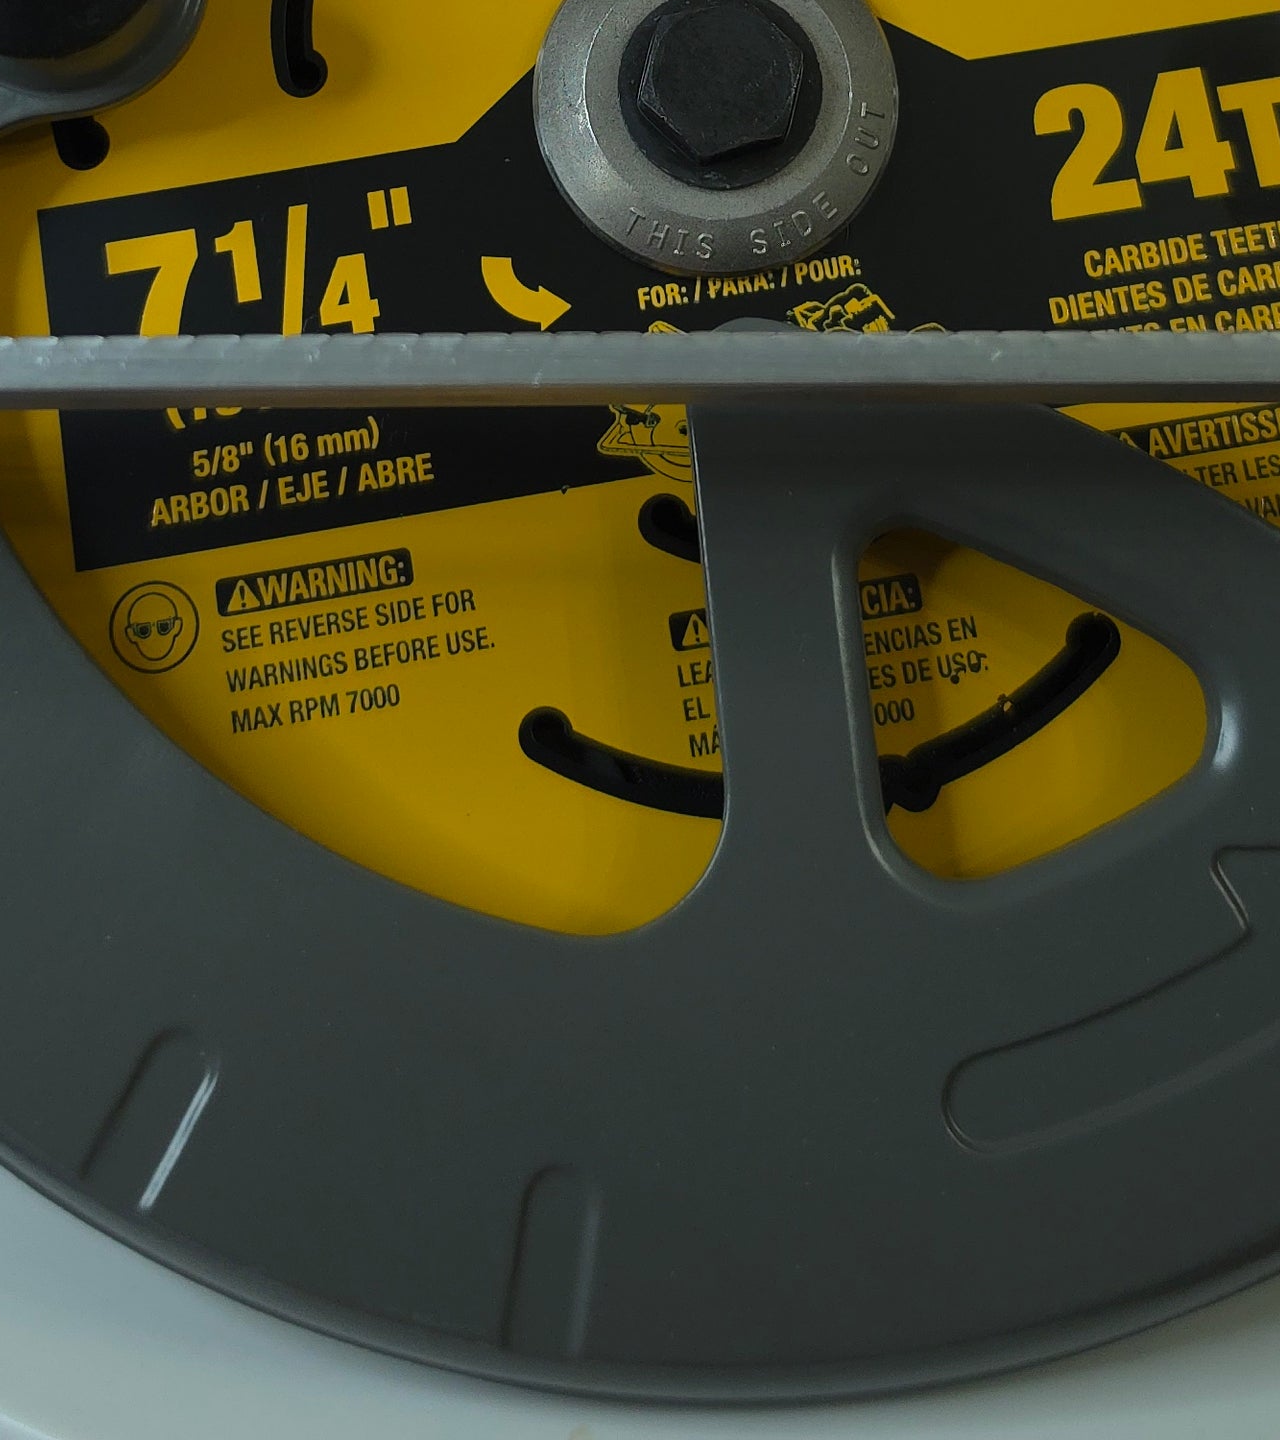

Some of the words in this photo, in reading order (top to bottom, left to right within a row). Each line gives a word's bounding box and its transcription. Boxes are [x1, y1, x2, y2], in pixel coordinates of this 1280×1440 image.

[624, 206, 715, 259] THIS
[749, 190, 838, 255] SIDE
[846, 101, 885, 177] OUT
[1083, 232, 1207, 278] CARBIDE
[637, 282, 690, 311] FOR:
[707, 271, 775, 299] PARA:
[793, 254, 862, 286] POUR:
[1048, 281, 1167, 325] DIENTES
[1172, 272, 1213, 305] DE
[192, 441, 254, 478] 5/8"
[263, 432, 310, 467] (16
[316, 415, 380, 458] mm)
[150, 484, 251, 528] ARBOR
[258, 479, 269, 509] /
[278, 470, 330, 506] EJE
[337, 465, 348, 496] /
[357, 452, 435, 492] ABRE
[256, 555, 408, 607] WARNING:
[222, 629, 263, 653] SEE
[269, 607, 370, 645] REVERSE
[375, 596, 427, 626] SIDE
[431, 588, 477, 617] FOR
[947, 615, 977, 642] EN
[226, 653, 349, 693] WARNINGS
[354, 634, 442, 672] BEFORE
[446, 627, 496, 656] USE.
[901, 658, 934, 685] DE
[231, 703, 283, 734] MAX
[289, 693, 340, 724] RPM
[345, 684, 401, 714] 7000
[683, 696, 711, 722] EL
[873, 697, 915, 726] 000
